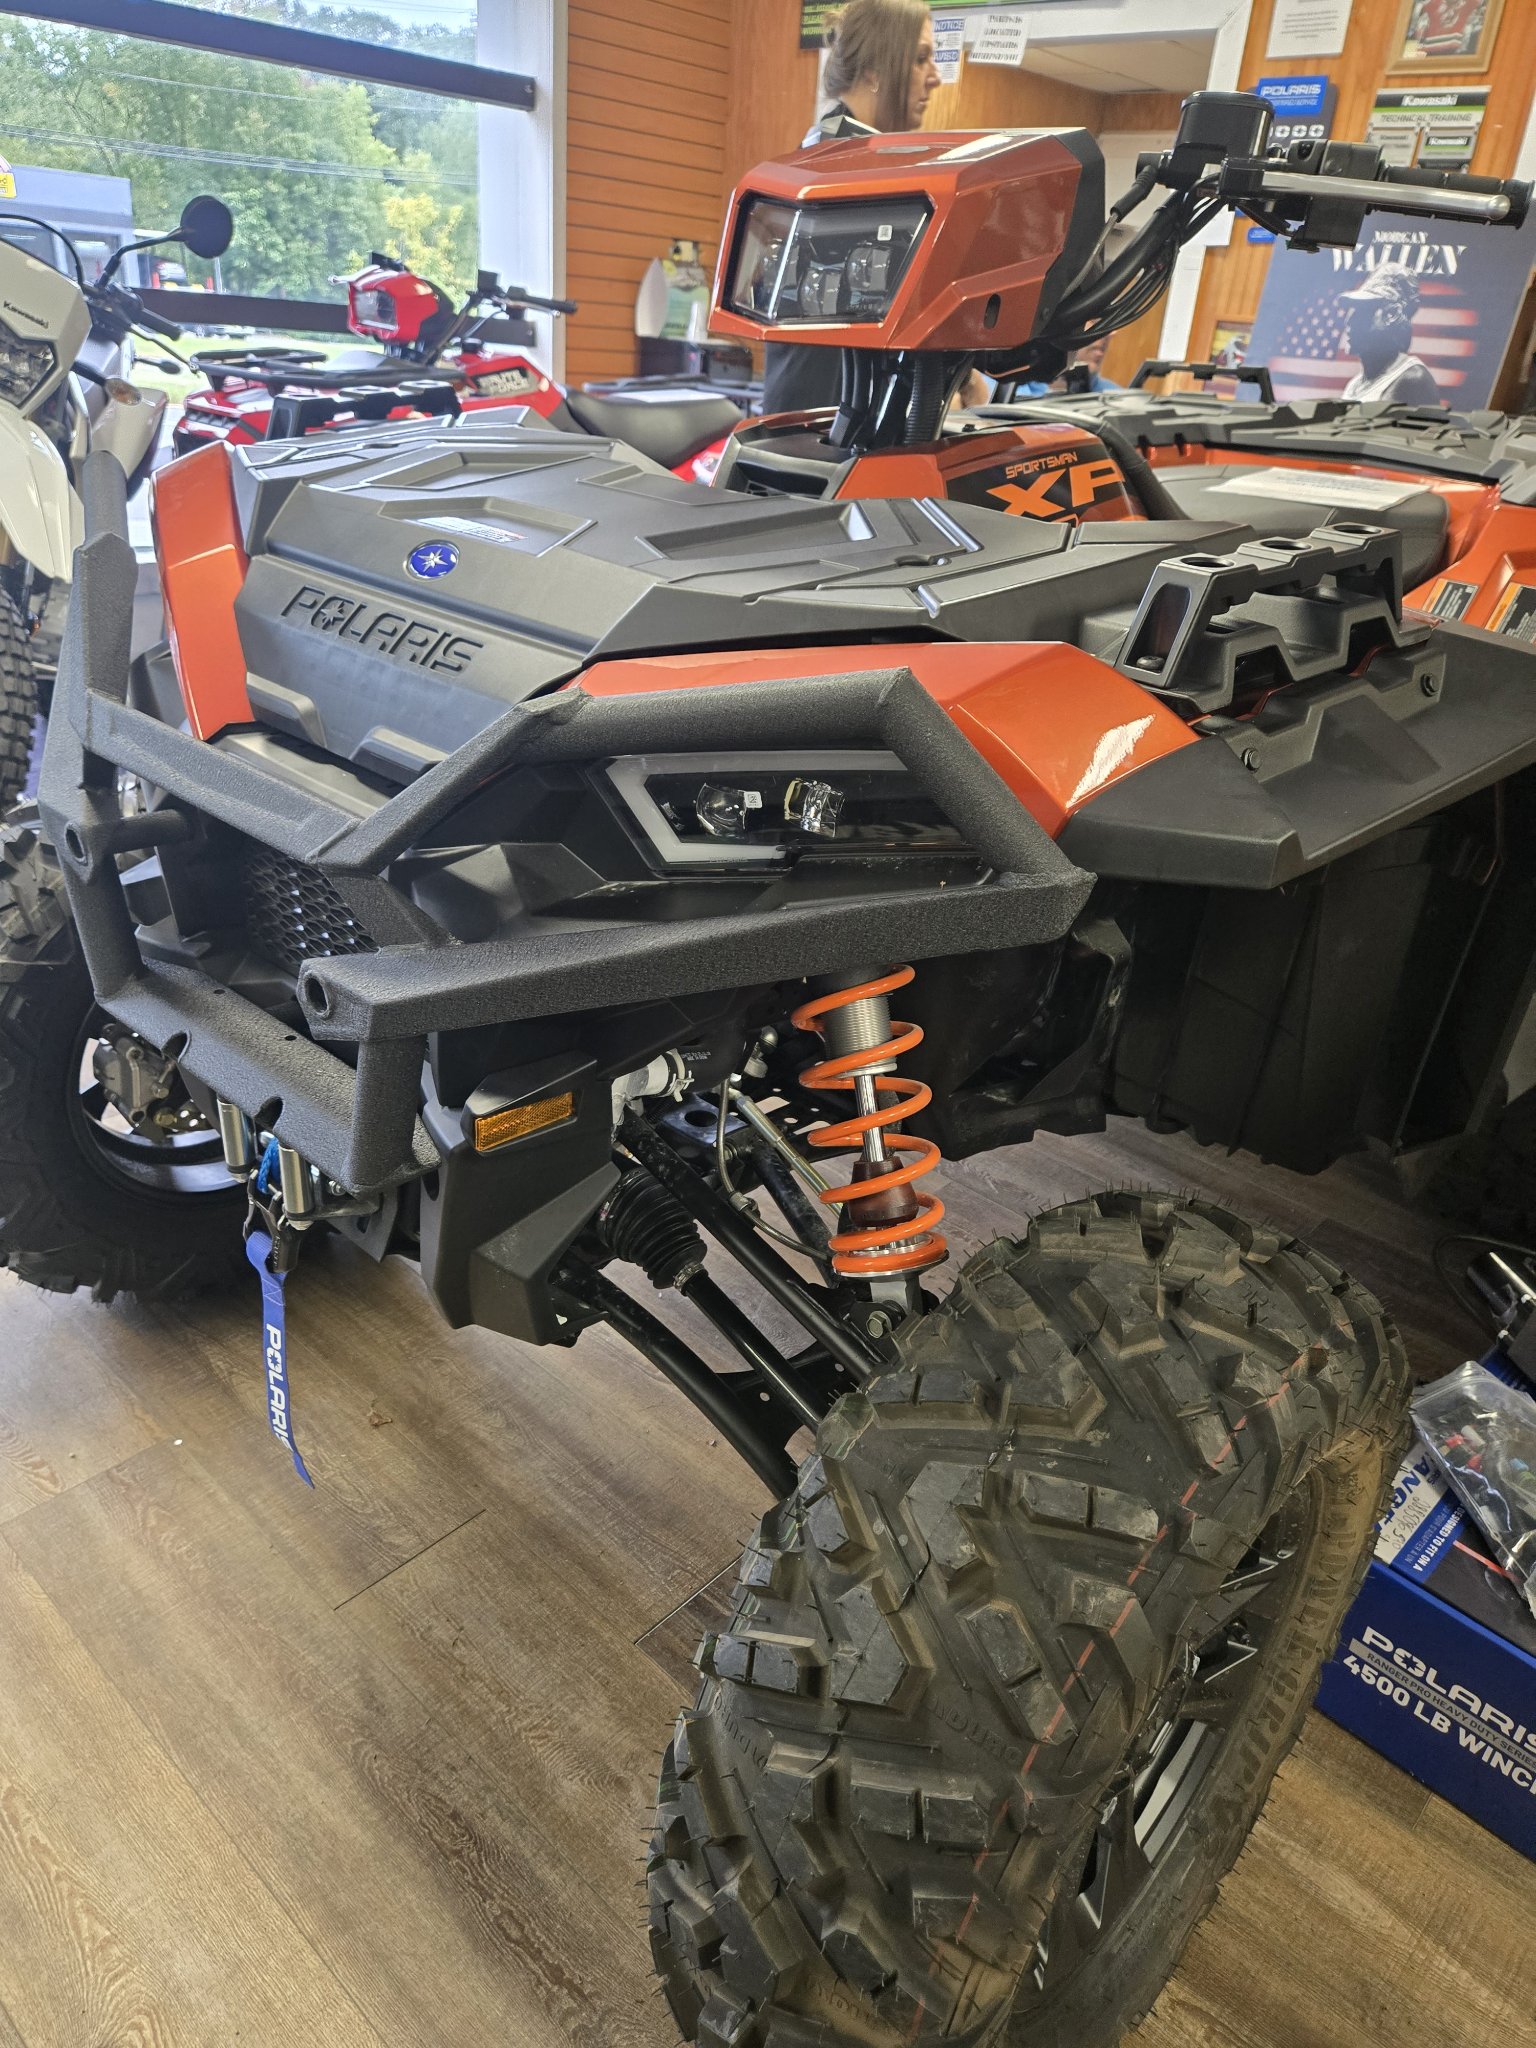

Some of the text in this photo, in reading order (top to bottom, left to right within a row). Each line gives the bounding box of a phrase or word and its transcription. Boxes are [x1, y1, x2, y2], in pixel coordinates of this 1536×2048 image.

[935, 20, 964, 30] NOTICE
[1261, 84, 1321, 96] POLARIS
[1401, 94, 1458, 106] Kawasaki
[1382, 113, 1472, 122] TECHNICAL TRAINING
[1374, 231, 1428, 243] MORGAN
[1332, 243, 1467, 275] WALLEN
[3, 300, 49, 329] Kawasaki
[1005, 451, 1078, 479] SPORTSMAN
[985, 458, 1126, 518] XP
[280, 584, 485, 674] POLARIS
[1432, 1534, 1445, 1548] TO
[1424, 1543, 1438, 1557] FIT
[1413, 1562, 1423, 1572] A
[1416, 1553, 1430, 1567] ON
[1343, 1655, 1410, 1707] 4500
[1413, 1699, 1451, 1734] LB
[1367, 1652, 1409, 1684] RANGER
[1410, 1682, 1431, 1699] PRO
[1432, 1695, 1470, 1723] HEAVY
[1469, 1718, 1500, 1742] DUTY
